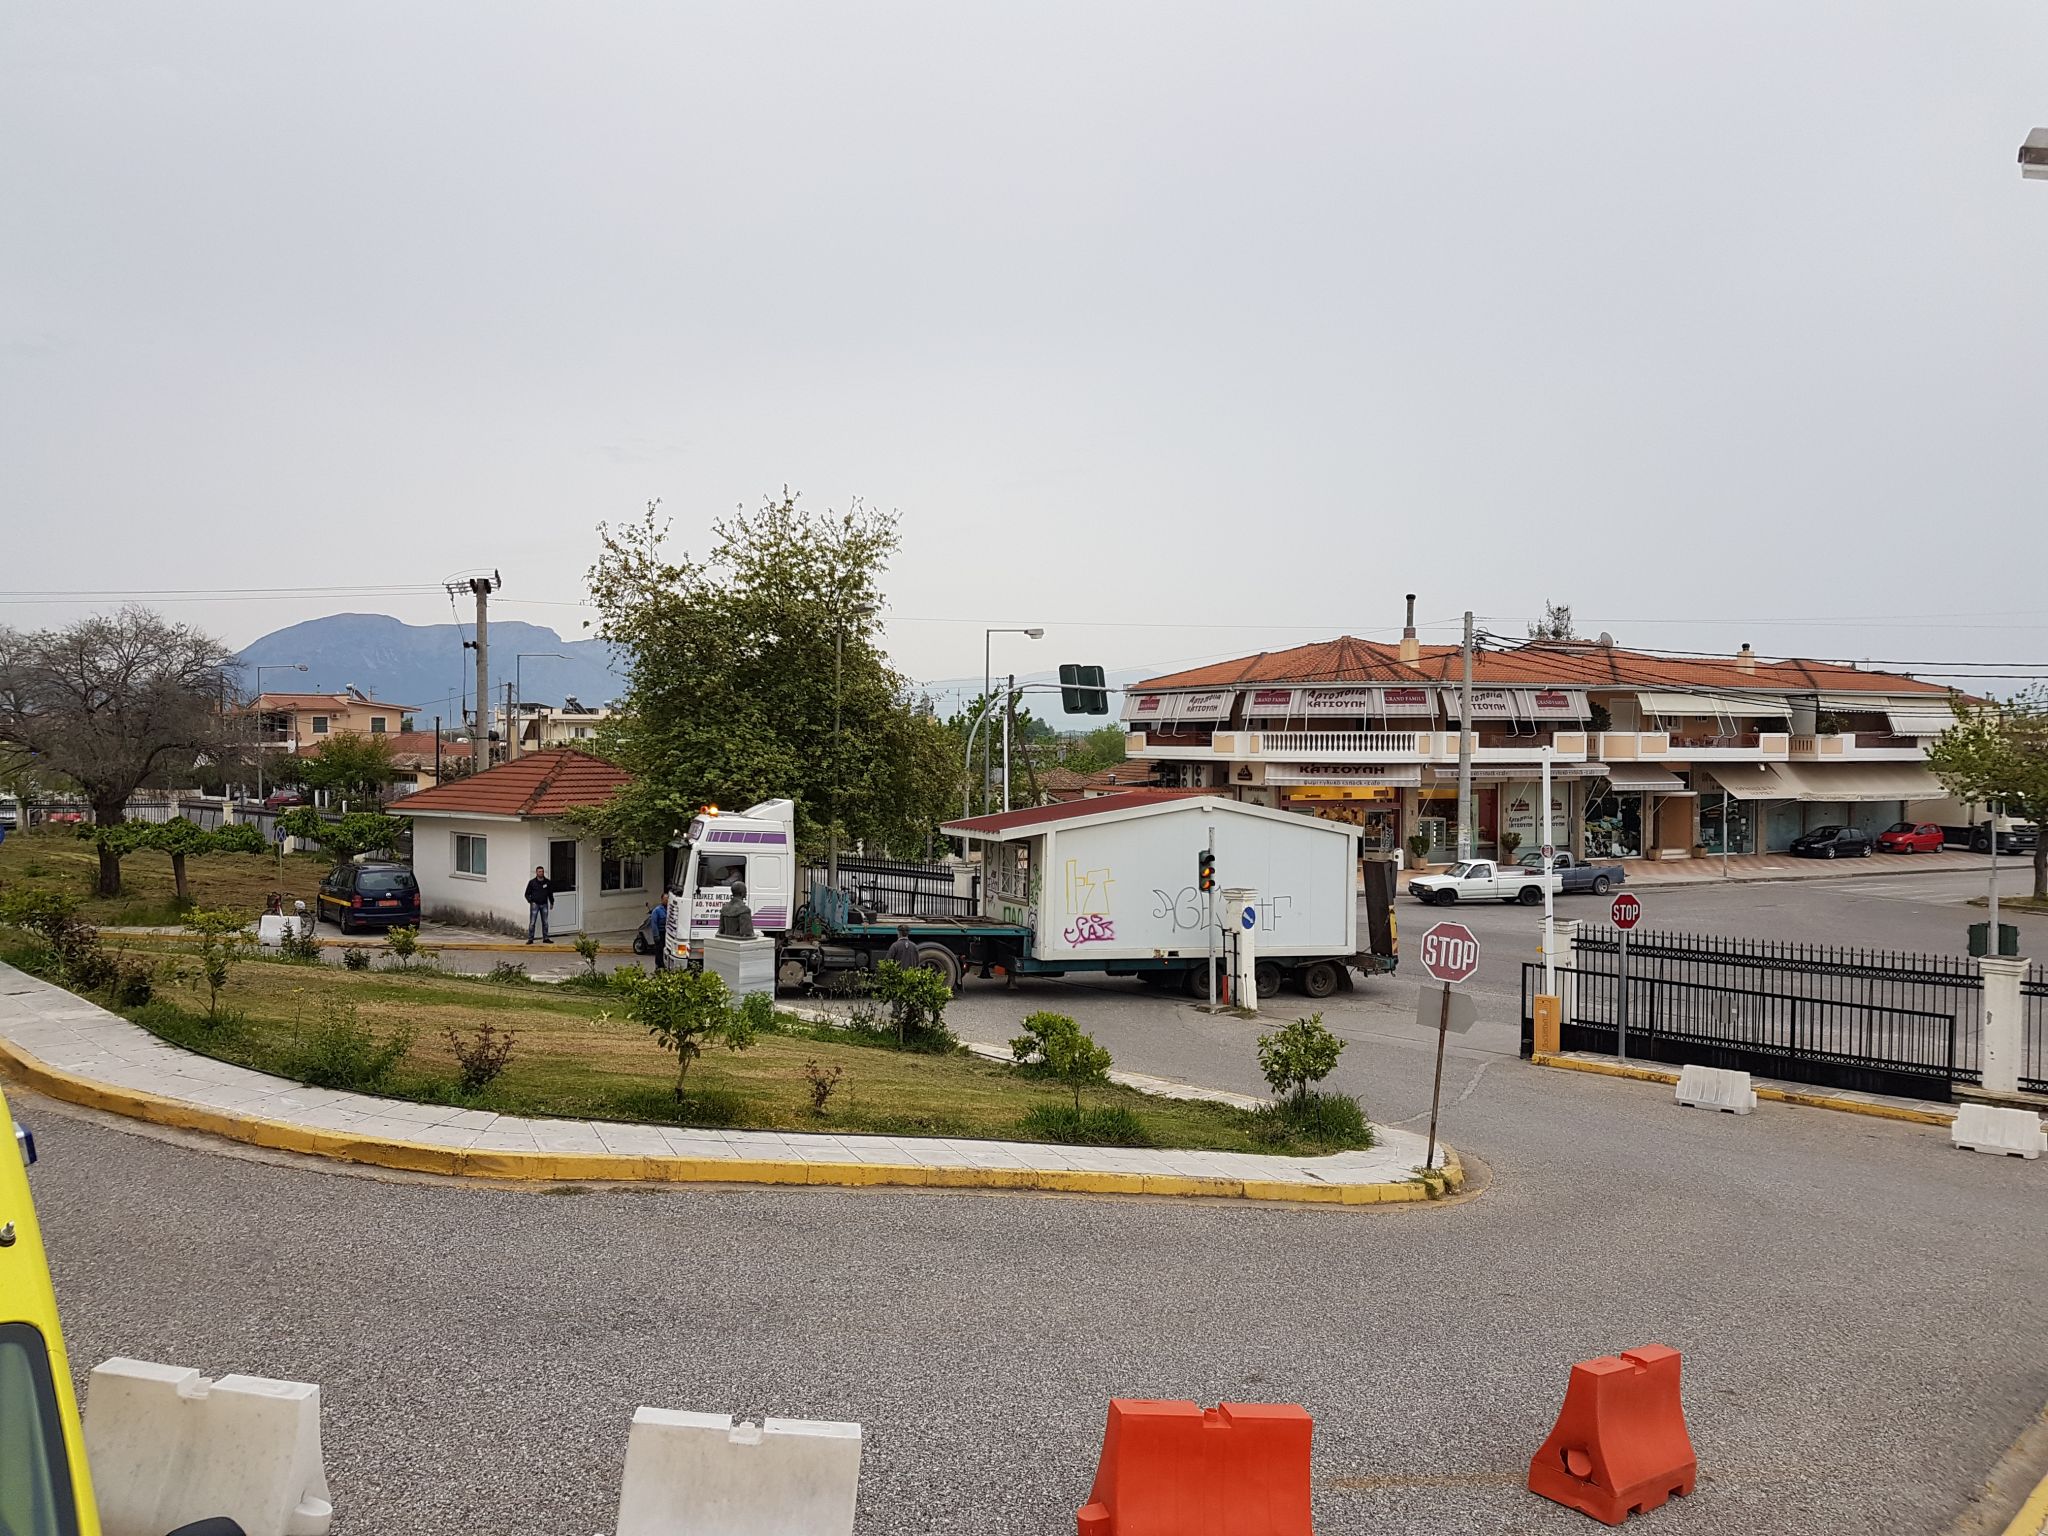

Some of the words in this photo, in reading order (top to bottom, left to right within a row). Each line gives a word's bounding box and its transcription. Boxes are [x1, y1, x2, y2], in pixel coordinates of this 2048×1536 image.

[1300, 766, 1385, 774] ΚΑΤΣΟΥΠΗ
[1613, 903, 1639, 921] STOP
[1425, 934, 1475, 971] STOP
